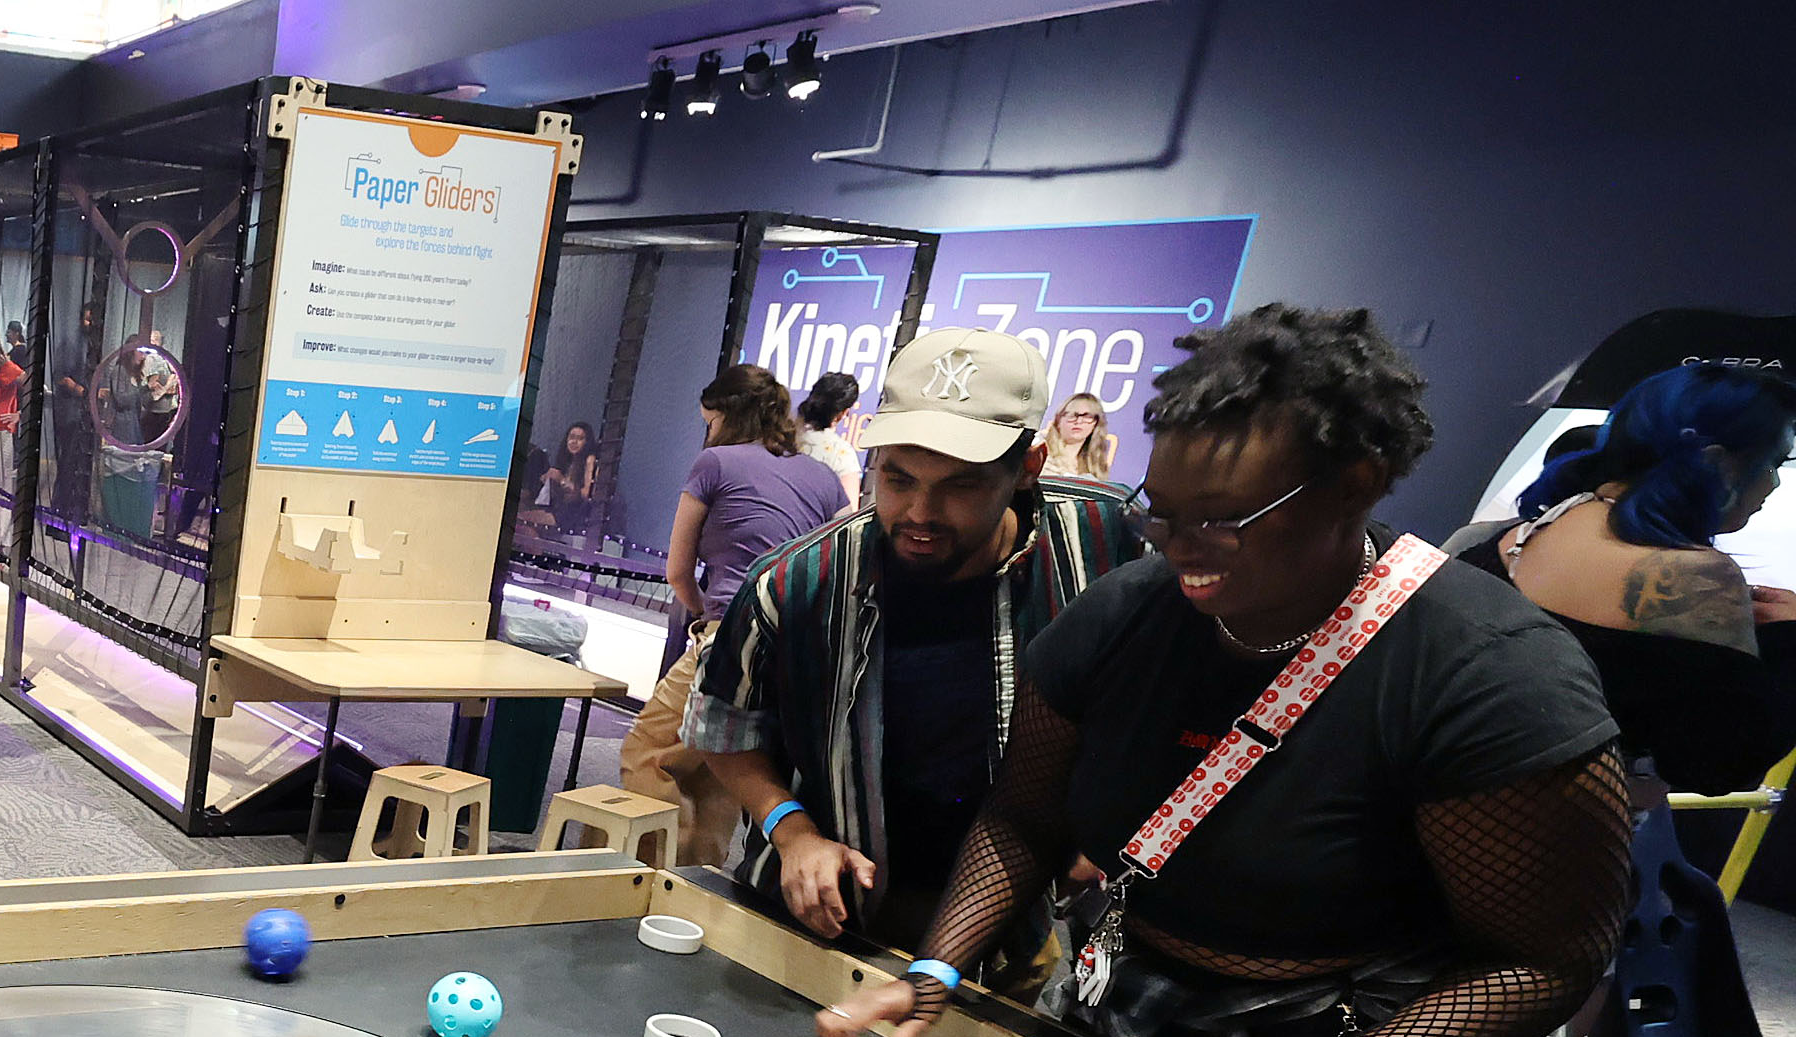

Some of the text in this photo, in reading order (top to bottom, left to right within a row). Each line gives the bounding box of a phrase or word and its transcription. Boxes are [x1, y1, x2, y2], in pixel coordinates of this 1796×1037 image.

[352, 166, 495, 214] Paper Gliders
[340, 214, 453, 238] Glide through the targets and
[375, 237, 493, 260] explore the forces behind flight
[311, 259, 346, 275] Imagine:
[309, 282, 327, 293] Ask:
[306, 304, 336, 317] Create:
[302, 339, 337, 353] Improve:
[756, 302, 936, 395] Kinet
[1681, 356, 1783, 369] CBRA
[921, 349, 980, 401] NY
[286, 387, 300, 398] Step
[337, 390, 350, 400] Step
[383, 394, 396, 404] Step
[427, 398, 440, 408] Step
[477, 401, 490, 411] Step
